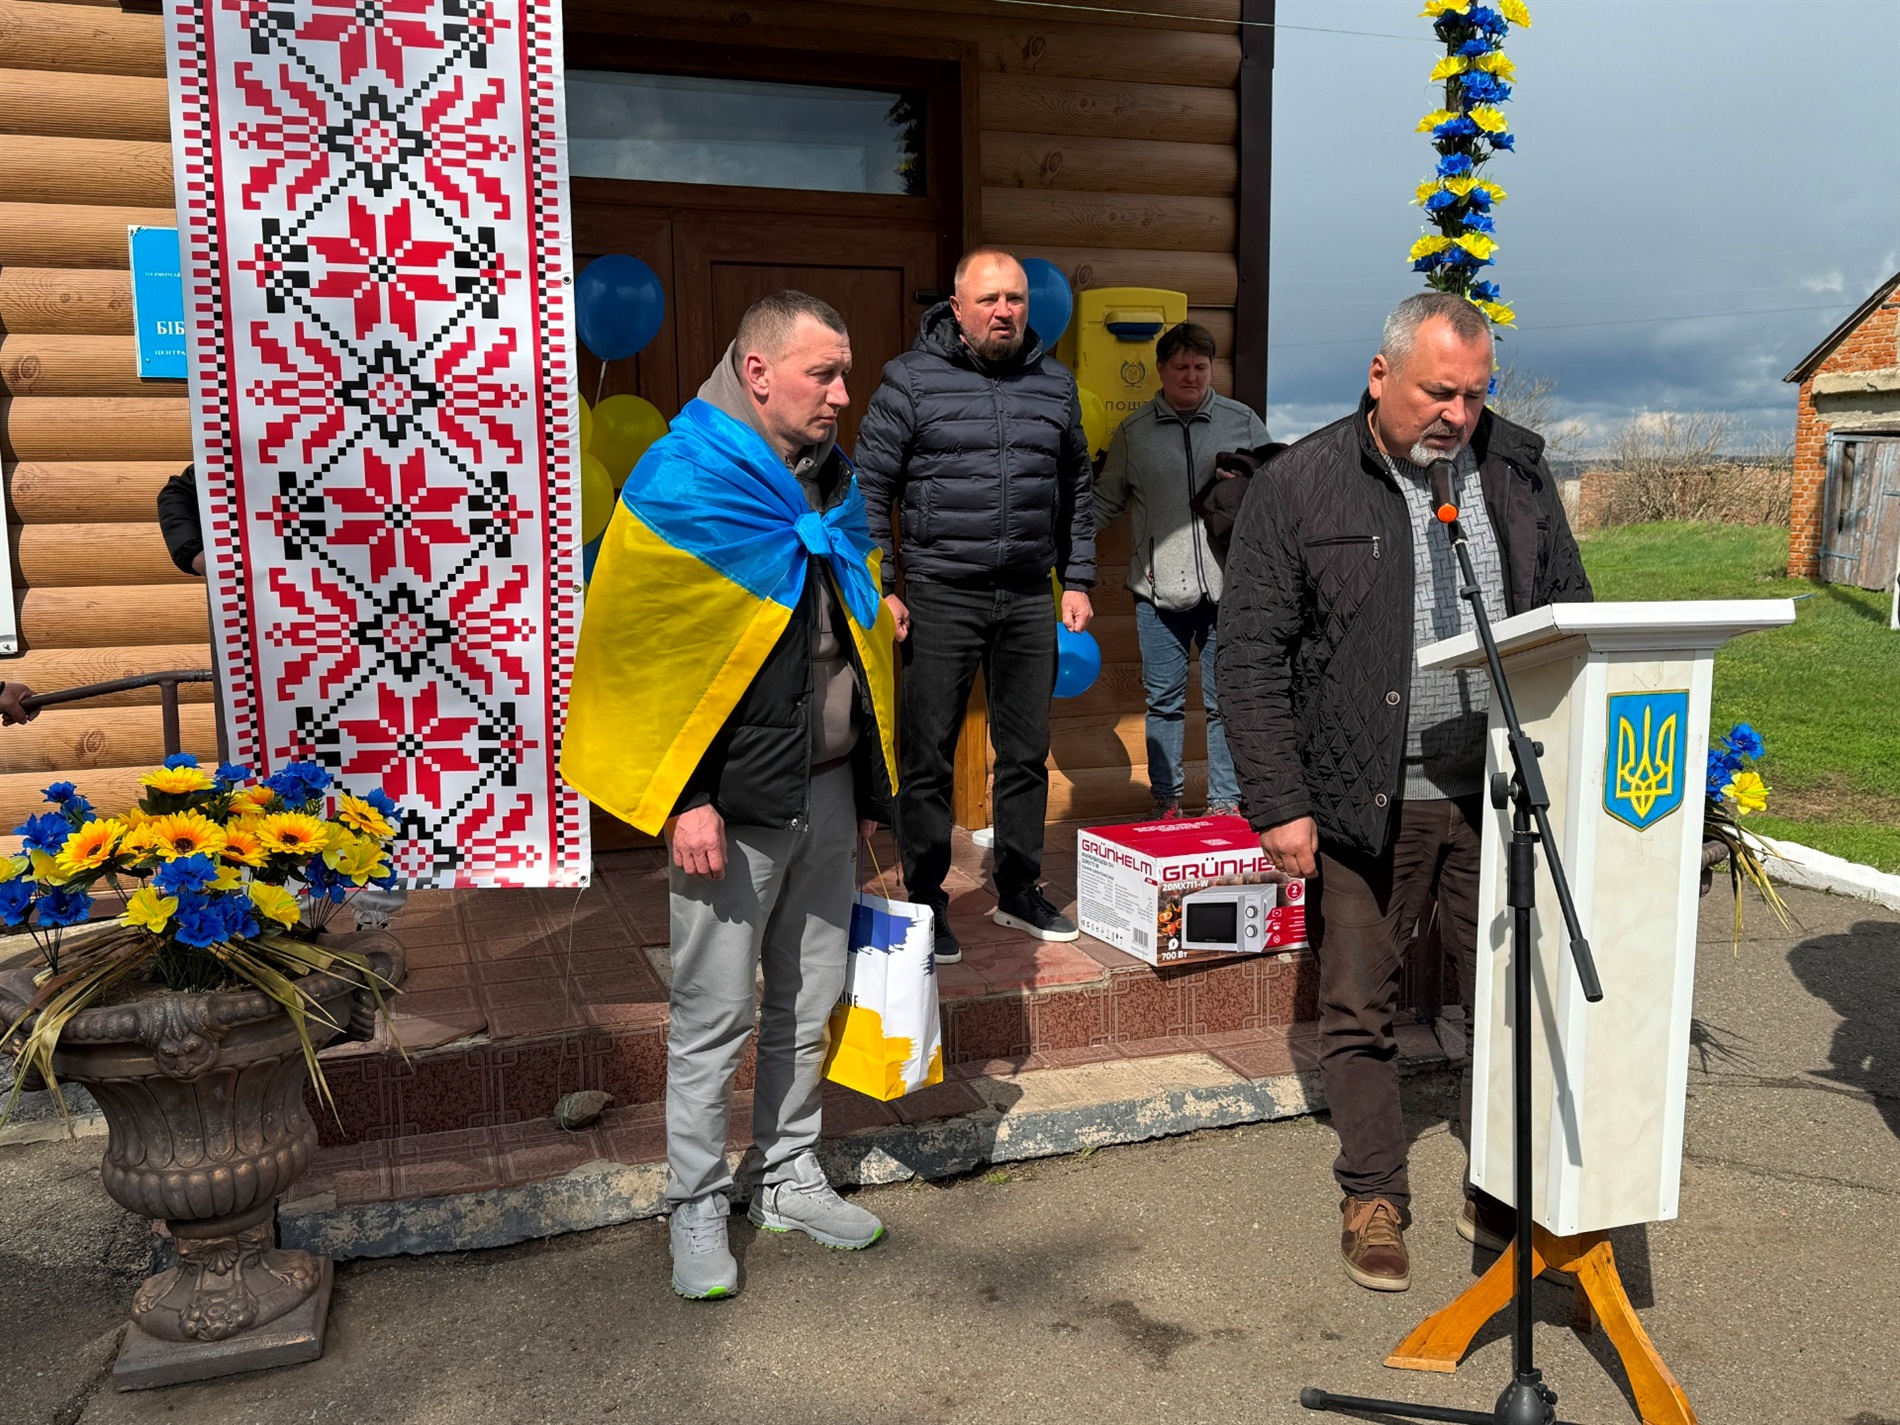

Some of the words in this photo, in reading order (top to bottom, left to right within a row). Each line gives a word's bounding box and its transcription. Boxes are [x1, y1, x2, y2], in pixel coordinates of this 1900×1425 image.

[1105, 400, 1148, 411] ПОШ
[1081, 839, 1153, 877] GRÜNHELM
[1162, 879, 1209, 892] 20MX711-W
[1161, 951, 1176, 961] 700
[1177, 950, 1188, 959] Вт
[840, 991, 858, 1009] INE
